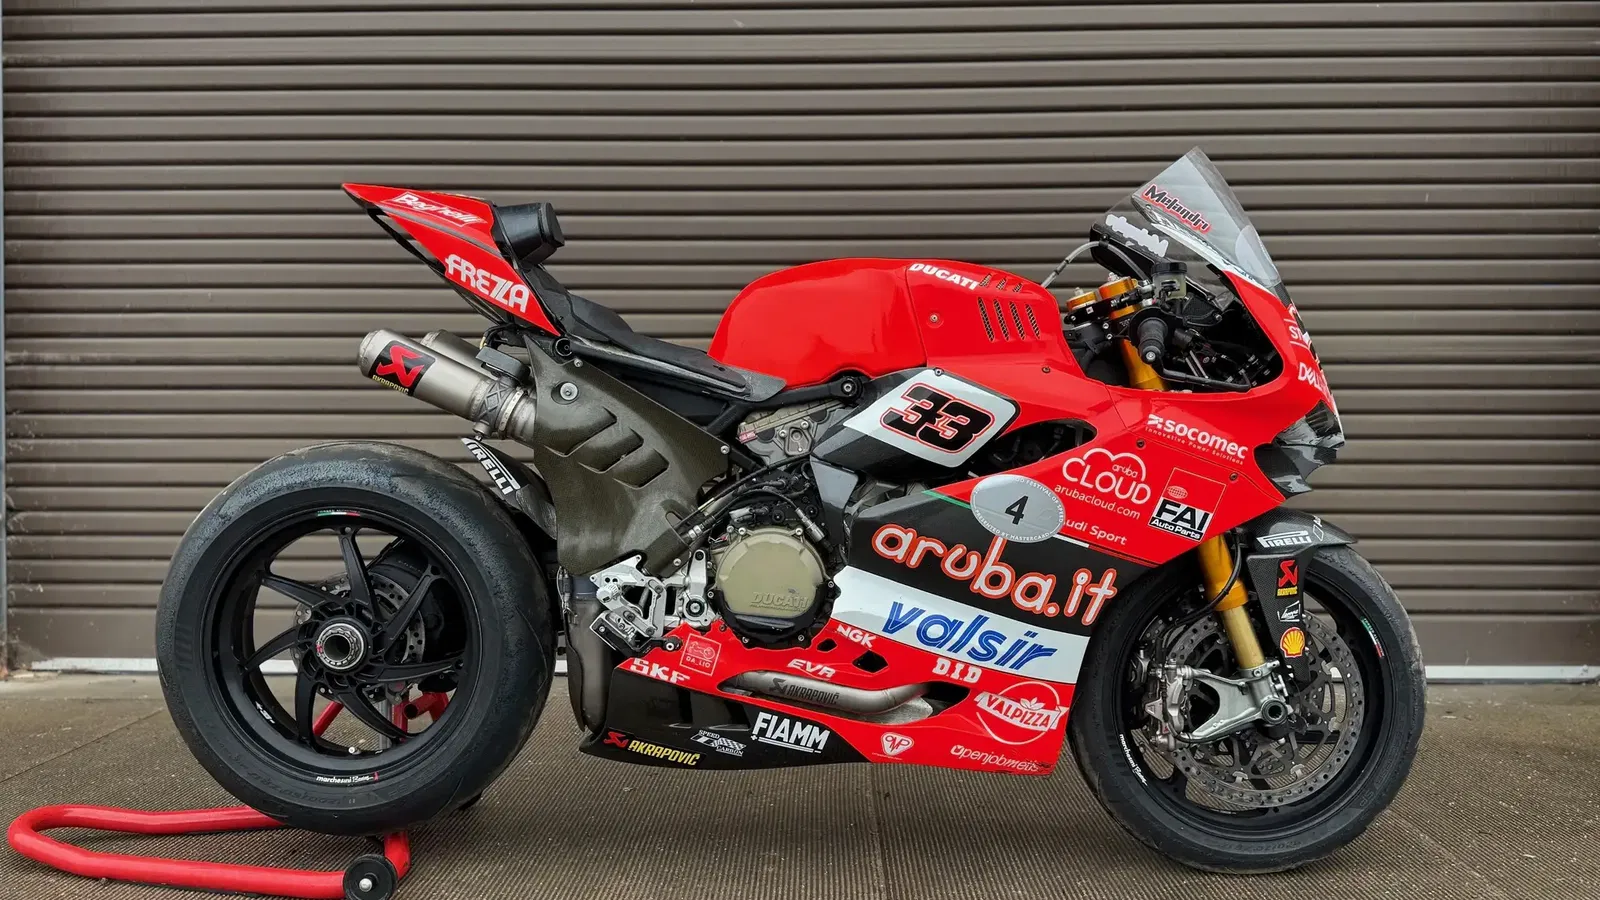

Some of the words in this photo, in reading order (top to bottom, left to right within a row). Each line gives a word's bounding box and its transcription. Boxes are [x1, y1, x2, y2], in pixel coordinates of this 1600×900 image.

[1144, 184, 1209, 230] Melandri
[908, 262, 980, 291] DUCATI
[880, 382, 995, 454] 33
[1145, 426, 1186, 445] Innovative
[1188, 441, 1209, 453] Power
[1211, 449, 1244, 466] Solutions
[1163, 419, 1248, 459] socomec
[460, 437, 521, 495] PIRELLI
[1062, 457, 1151, 505] CLOUD
[1112, 463, 1138, 478] aruba
[1025, 479, 1051, 497] FESTIVAL
[1051, 496, 1059, 505] OF
[1054, 483, 1141, 520] arubacloud.com
[974, 509, 1001, 535] PRESENTED
[1010, 532, 1050, 542] MASTERCARD
[1004, 495, 1029, 525] 4
[1156, 499, 1212, 531] FAI
[1063, 519, 1088, 532] udi
[1089, 525, 1128, 546] Sport
[1151, 518, 1175, 531] Auto
[1174, 526, 1201, 540] Parts
[1256, 530, 1312, 549] PIRELLI
[872, 523, 1118, 626] aruba.it
[751, 591, 809, 609] DUCATI
[836, 624, 877, 648] NGK
[881, 601, 1058, 671] valsir
[630, 657, 690, 684] SKF
[984, 691, 1051, 729] VALPIZZA
[699, 729, 721, 740] SPEED
[752, 711, 830, 750] FIAMM
[716, 744, 744, 757] CARBON
